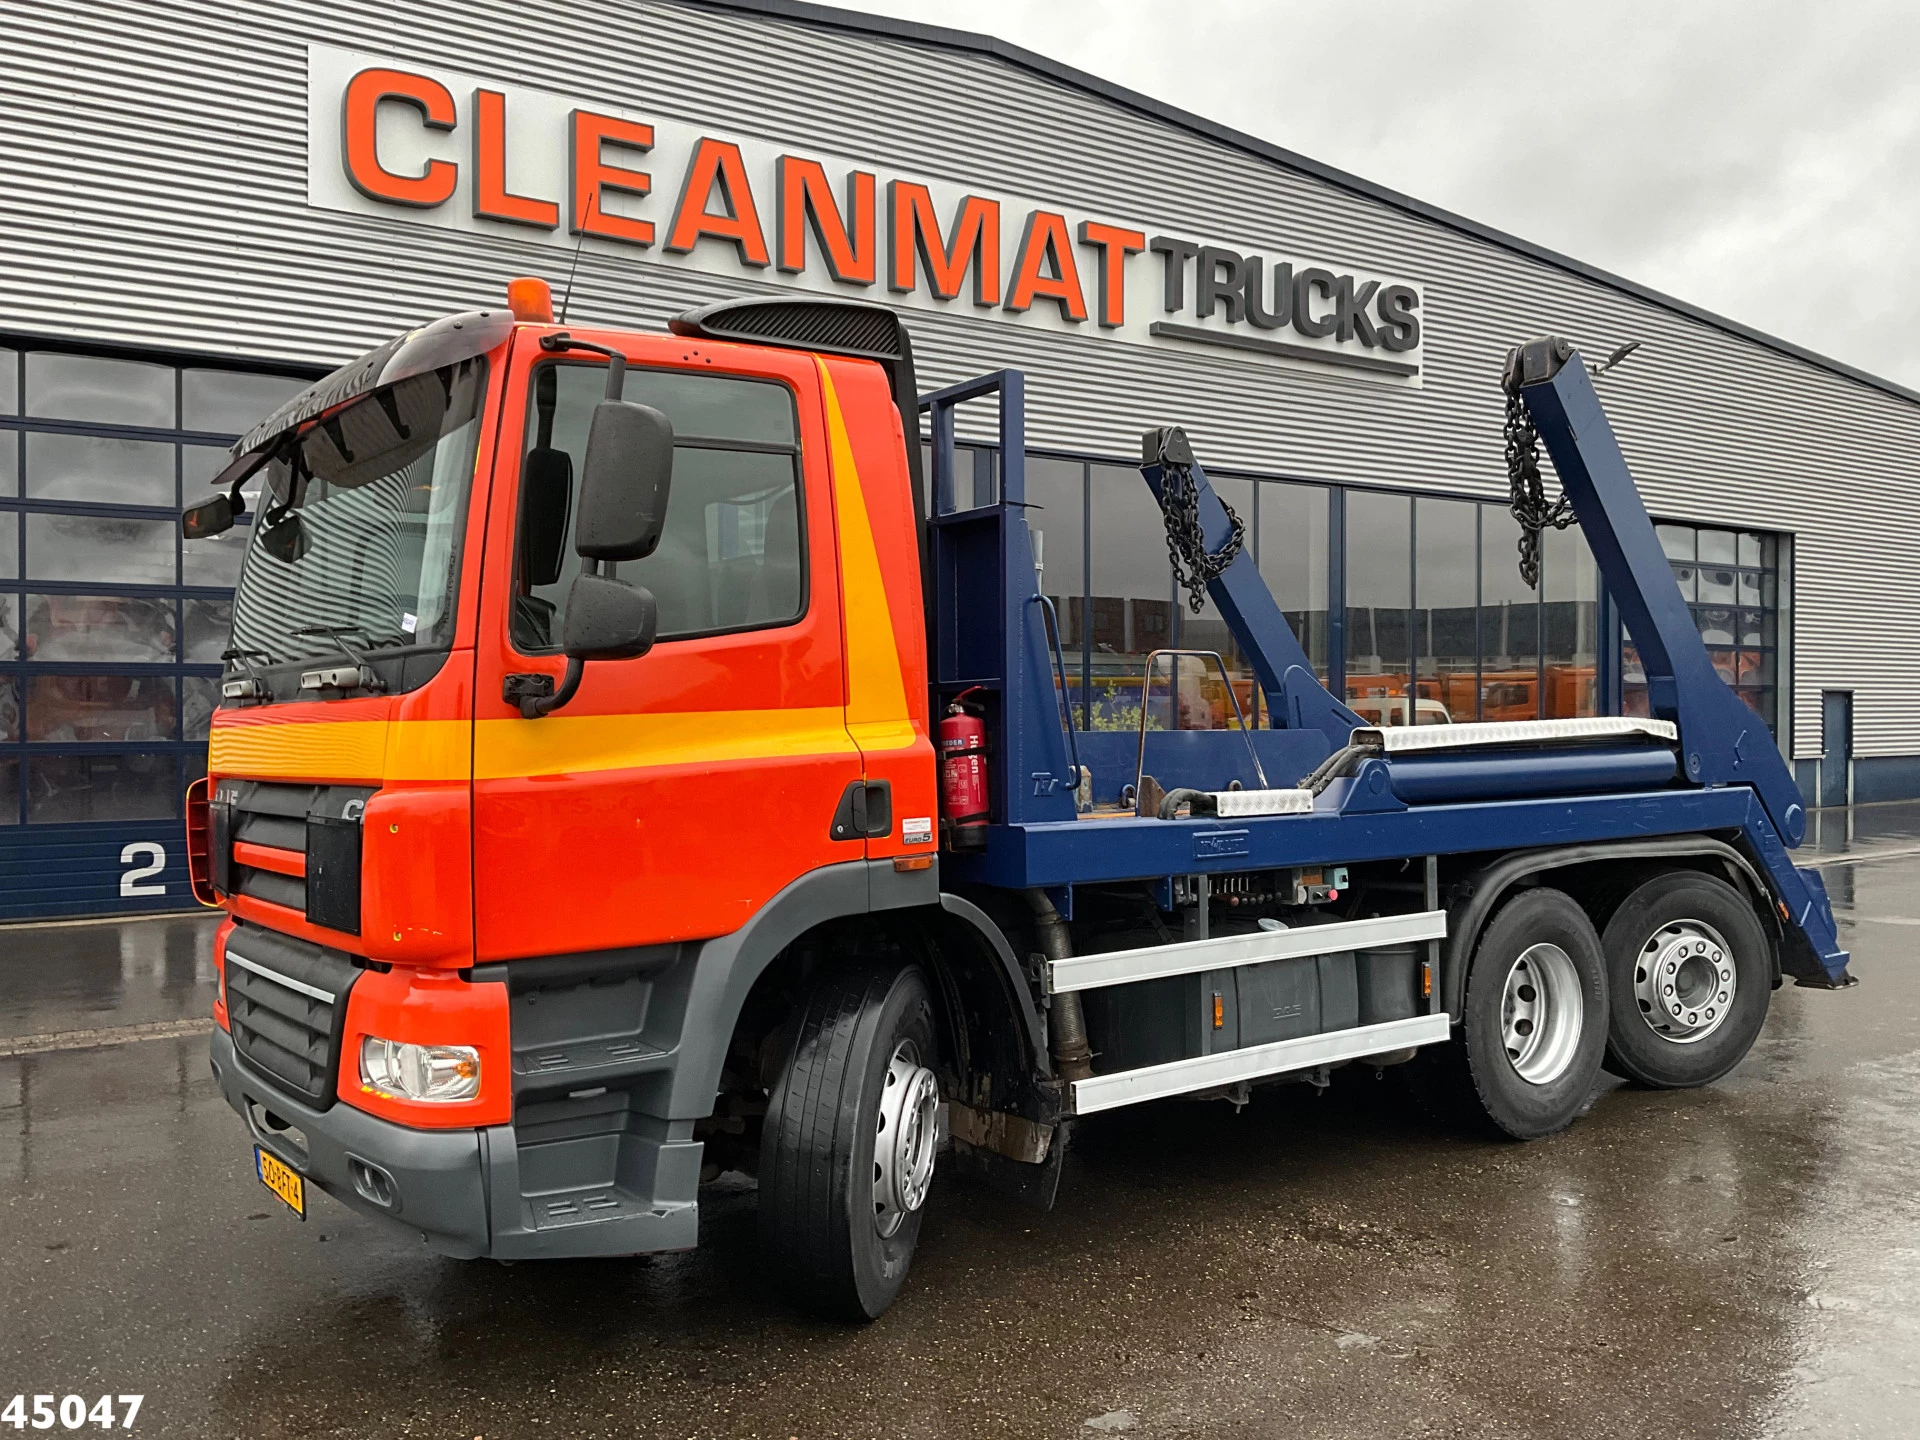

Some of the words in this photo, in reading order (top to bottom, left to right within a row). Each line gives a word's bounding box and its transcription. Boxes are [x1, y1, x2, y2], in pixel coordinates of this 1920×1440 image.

[341, 67, 1145, 329] CLEANMAT
[1150, 235, 1421, 353] TRUCKS
[922, 832, 931, 842] 5
[120, 842, 166, 896] 2
